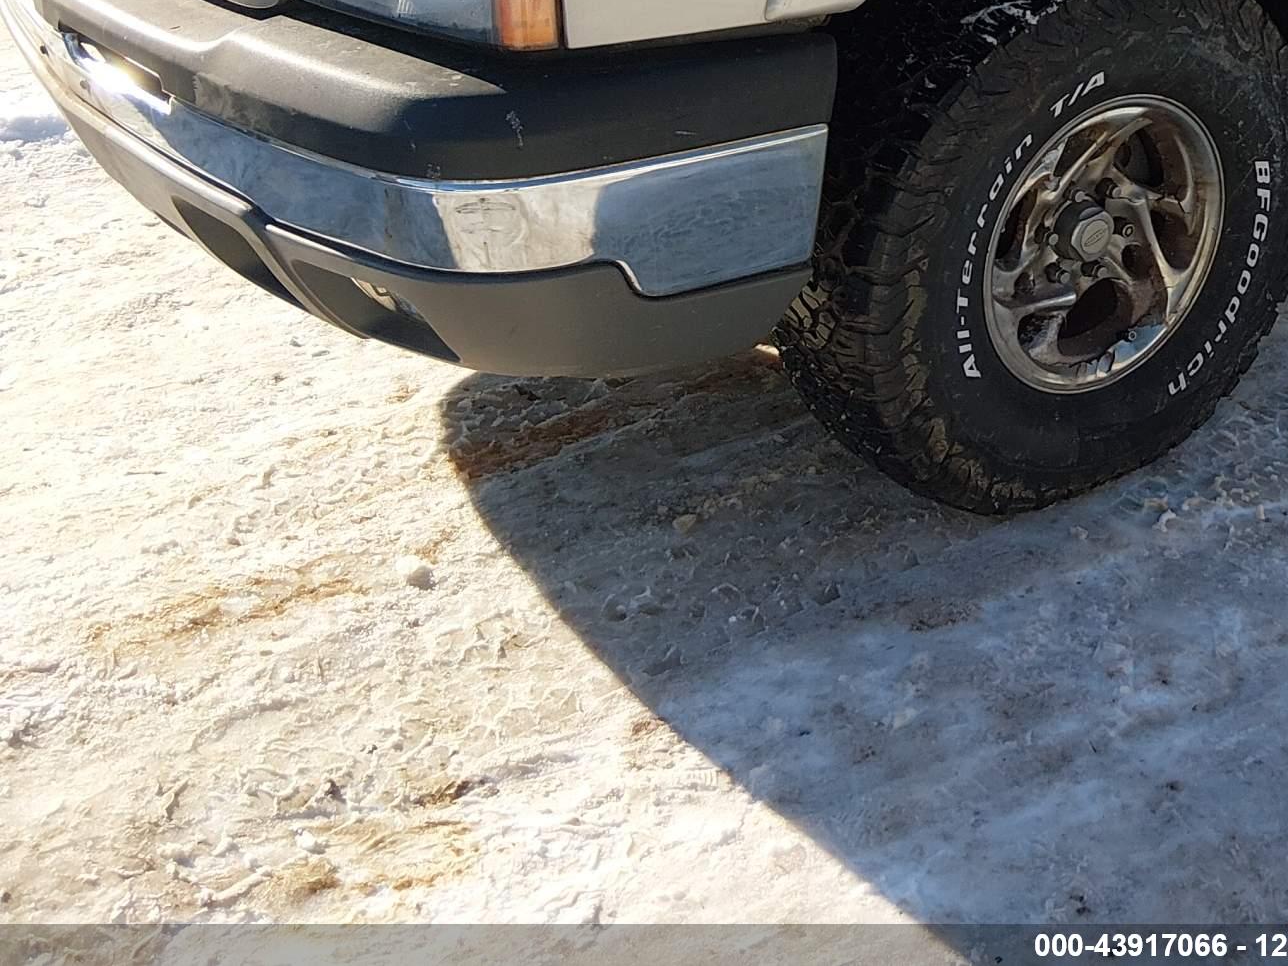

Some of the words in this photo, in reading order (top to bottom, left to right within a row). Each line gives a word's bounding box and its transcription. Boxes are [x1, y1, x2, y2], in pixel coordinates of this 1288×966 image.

[955, 133, 1033, 378] All-Terrain
[1049, 70, 1106, 118] T/A
[1167, 160, 1272, 396] BFGoodrich
